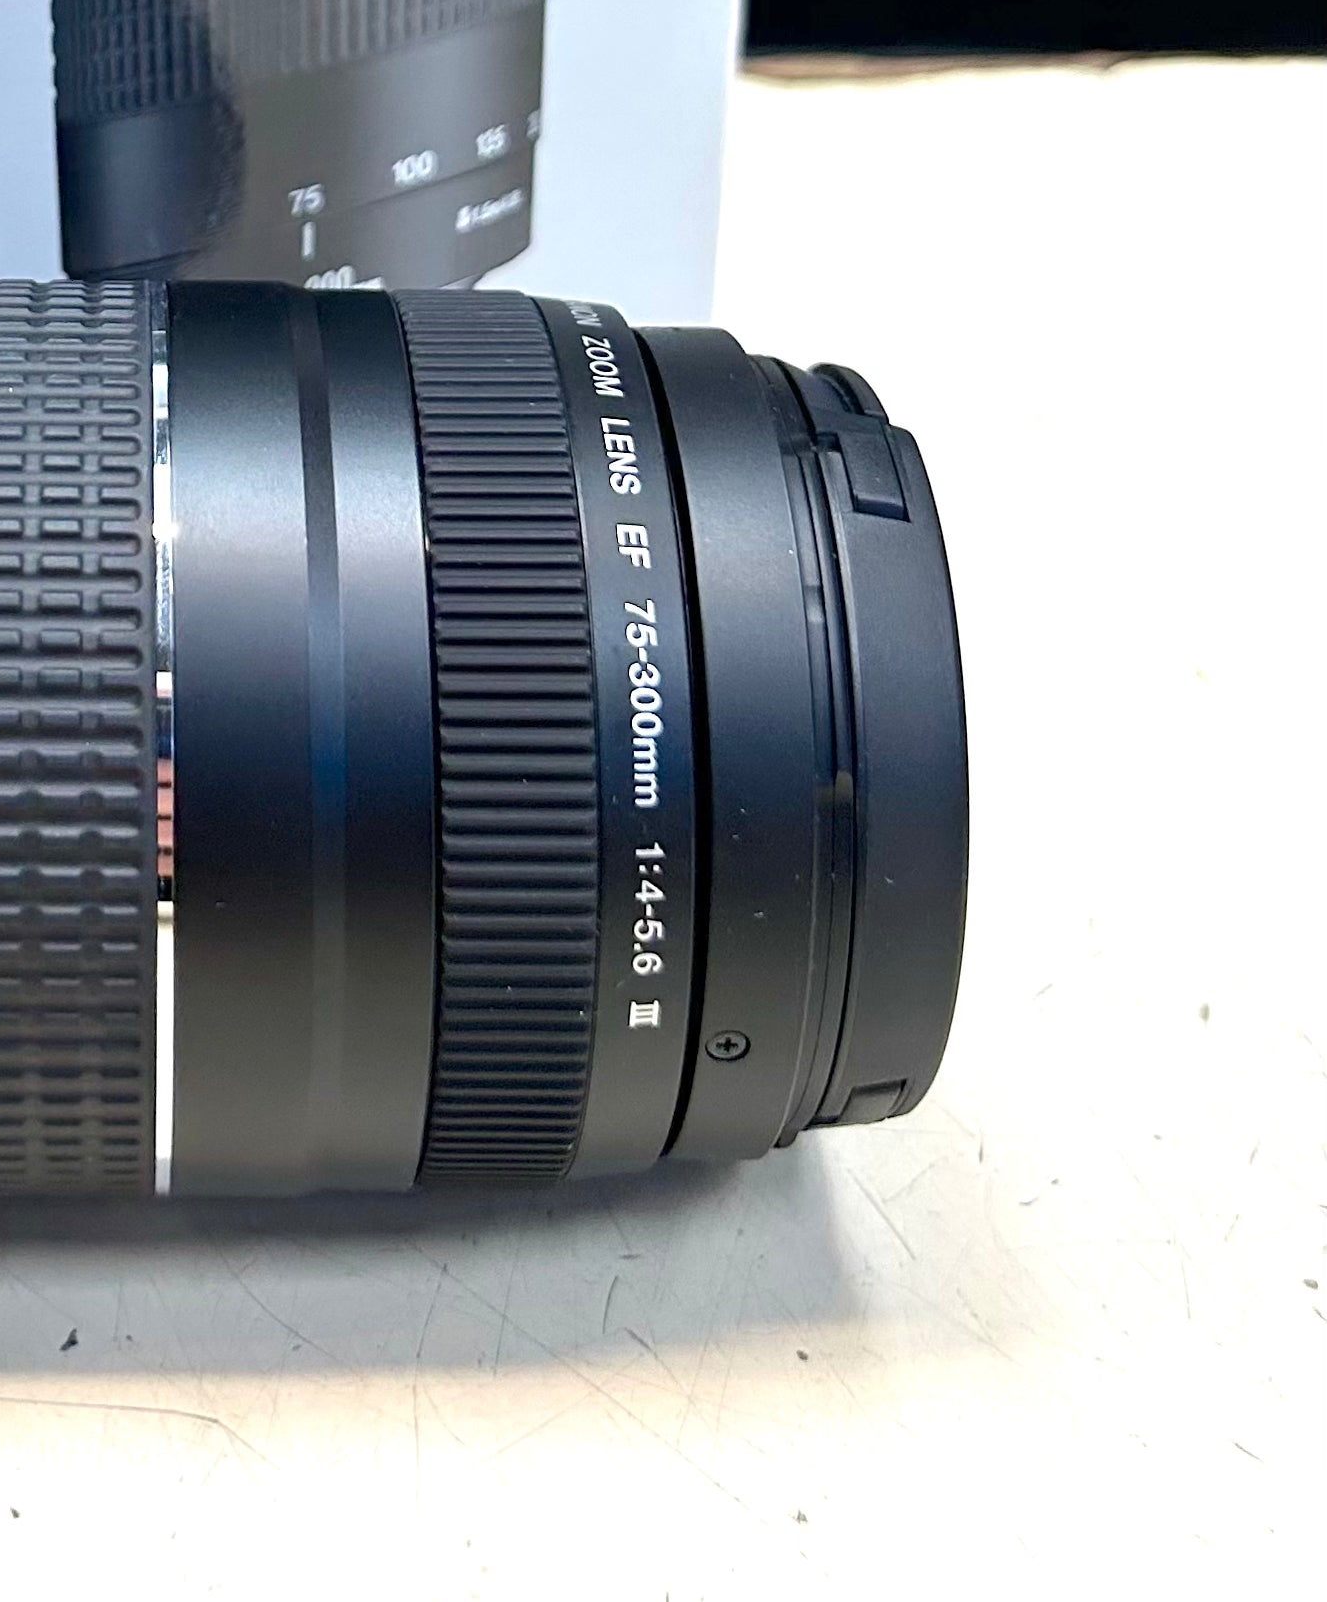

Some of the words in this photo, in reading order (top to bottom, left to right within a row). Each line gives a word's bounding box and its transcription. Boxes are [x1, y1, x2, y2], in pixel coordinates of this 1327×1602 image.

[288, 183, 325, 217] 75
[392, 149, 438, 187] 100
[582, 334, 624, 399] ZOOM
[600, 416, 642, 496] LENS
[615, 522, 652, 570] EF
[624, 599, 665, 808] 75-300mm
[632, 841, 667, 977] 1:4-5.6
